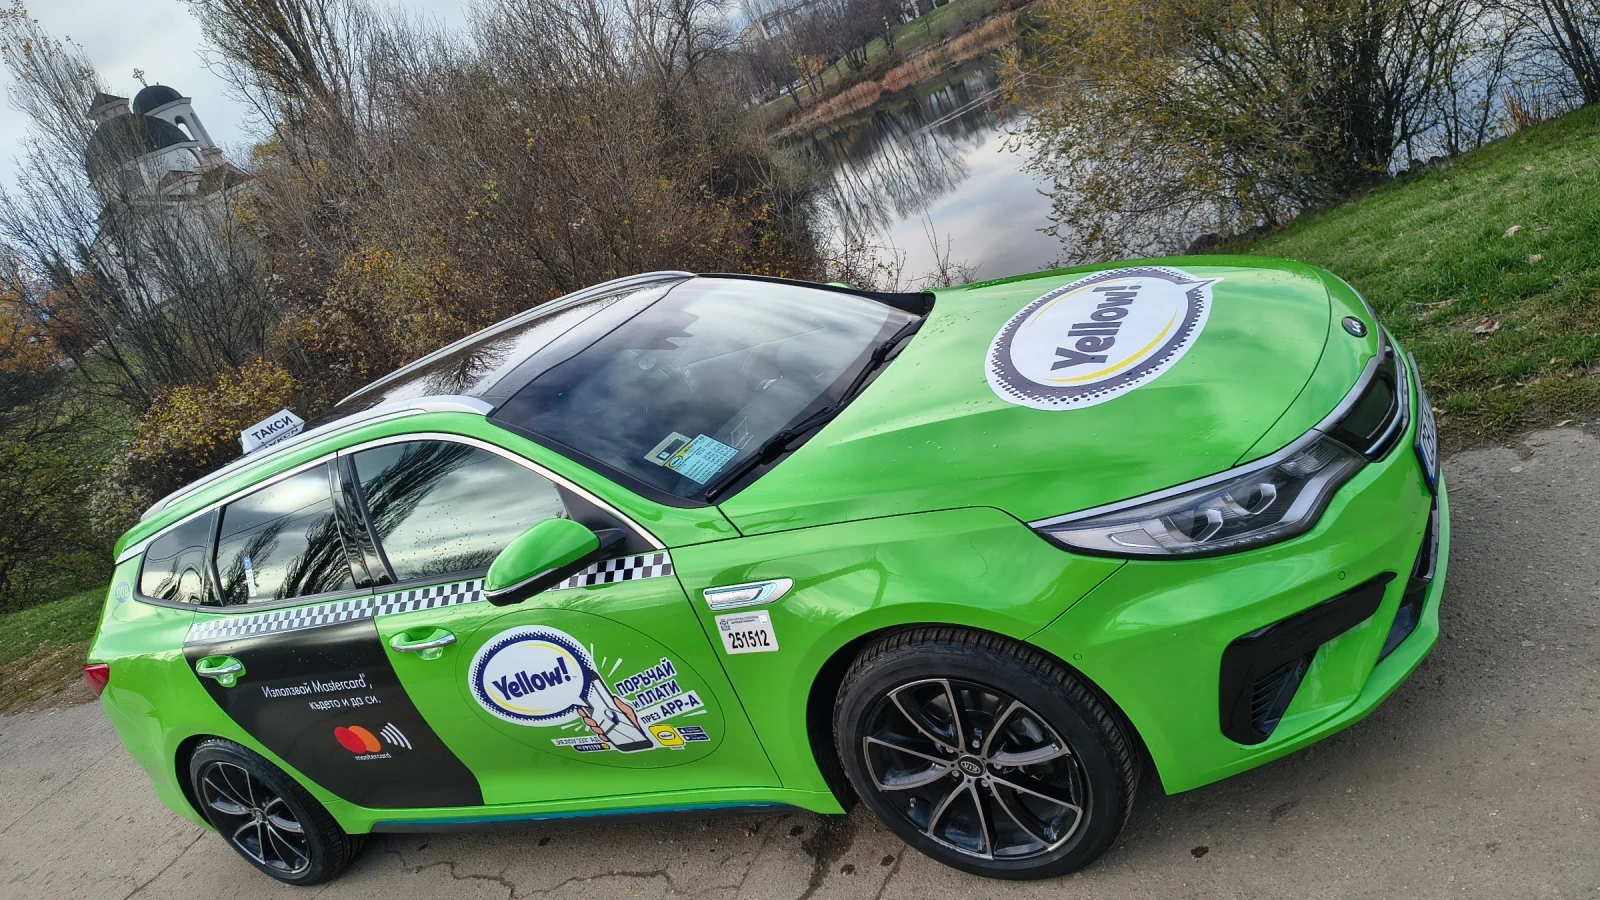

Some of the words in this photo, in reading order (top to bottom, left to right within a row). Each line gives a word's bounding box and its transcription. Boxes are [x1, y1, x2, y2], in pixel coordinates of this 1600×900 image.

[1050, 285, 1142, 371] Yellow!
[251, 415, 293, 440] ТАКСИ
[728, 629, 770, 649] 251512
[491, 656, 571, 701] Yellow!
[615, 658, 676, 696] ПОРЪЧАЙ
[261, 682, 312, 698] Използвай
[308, 699, 341, 711] където
[341, 698, 350, 707] и
[351, 696, 364, 708] да
[365, 694, 382, 705] си.
[637, 680, 681, 706] ПЛАТИ
[640, 712, 661, 724] ПРЕЗ
